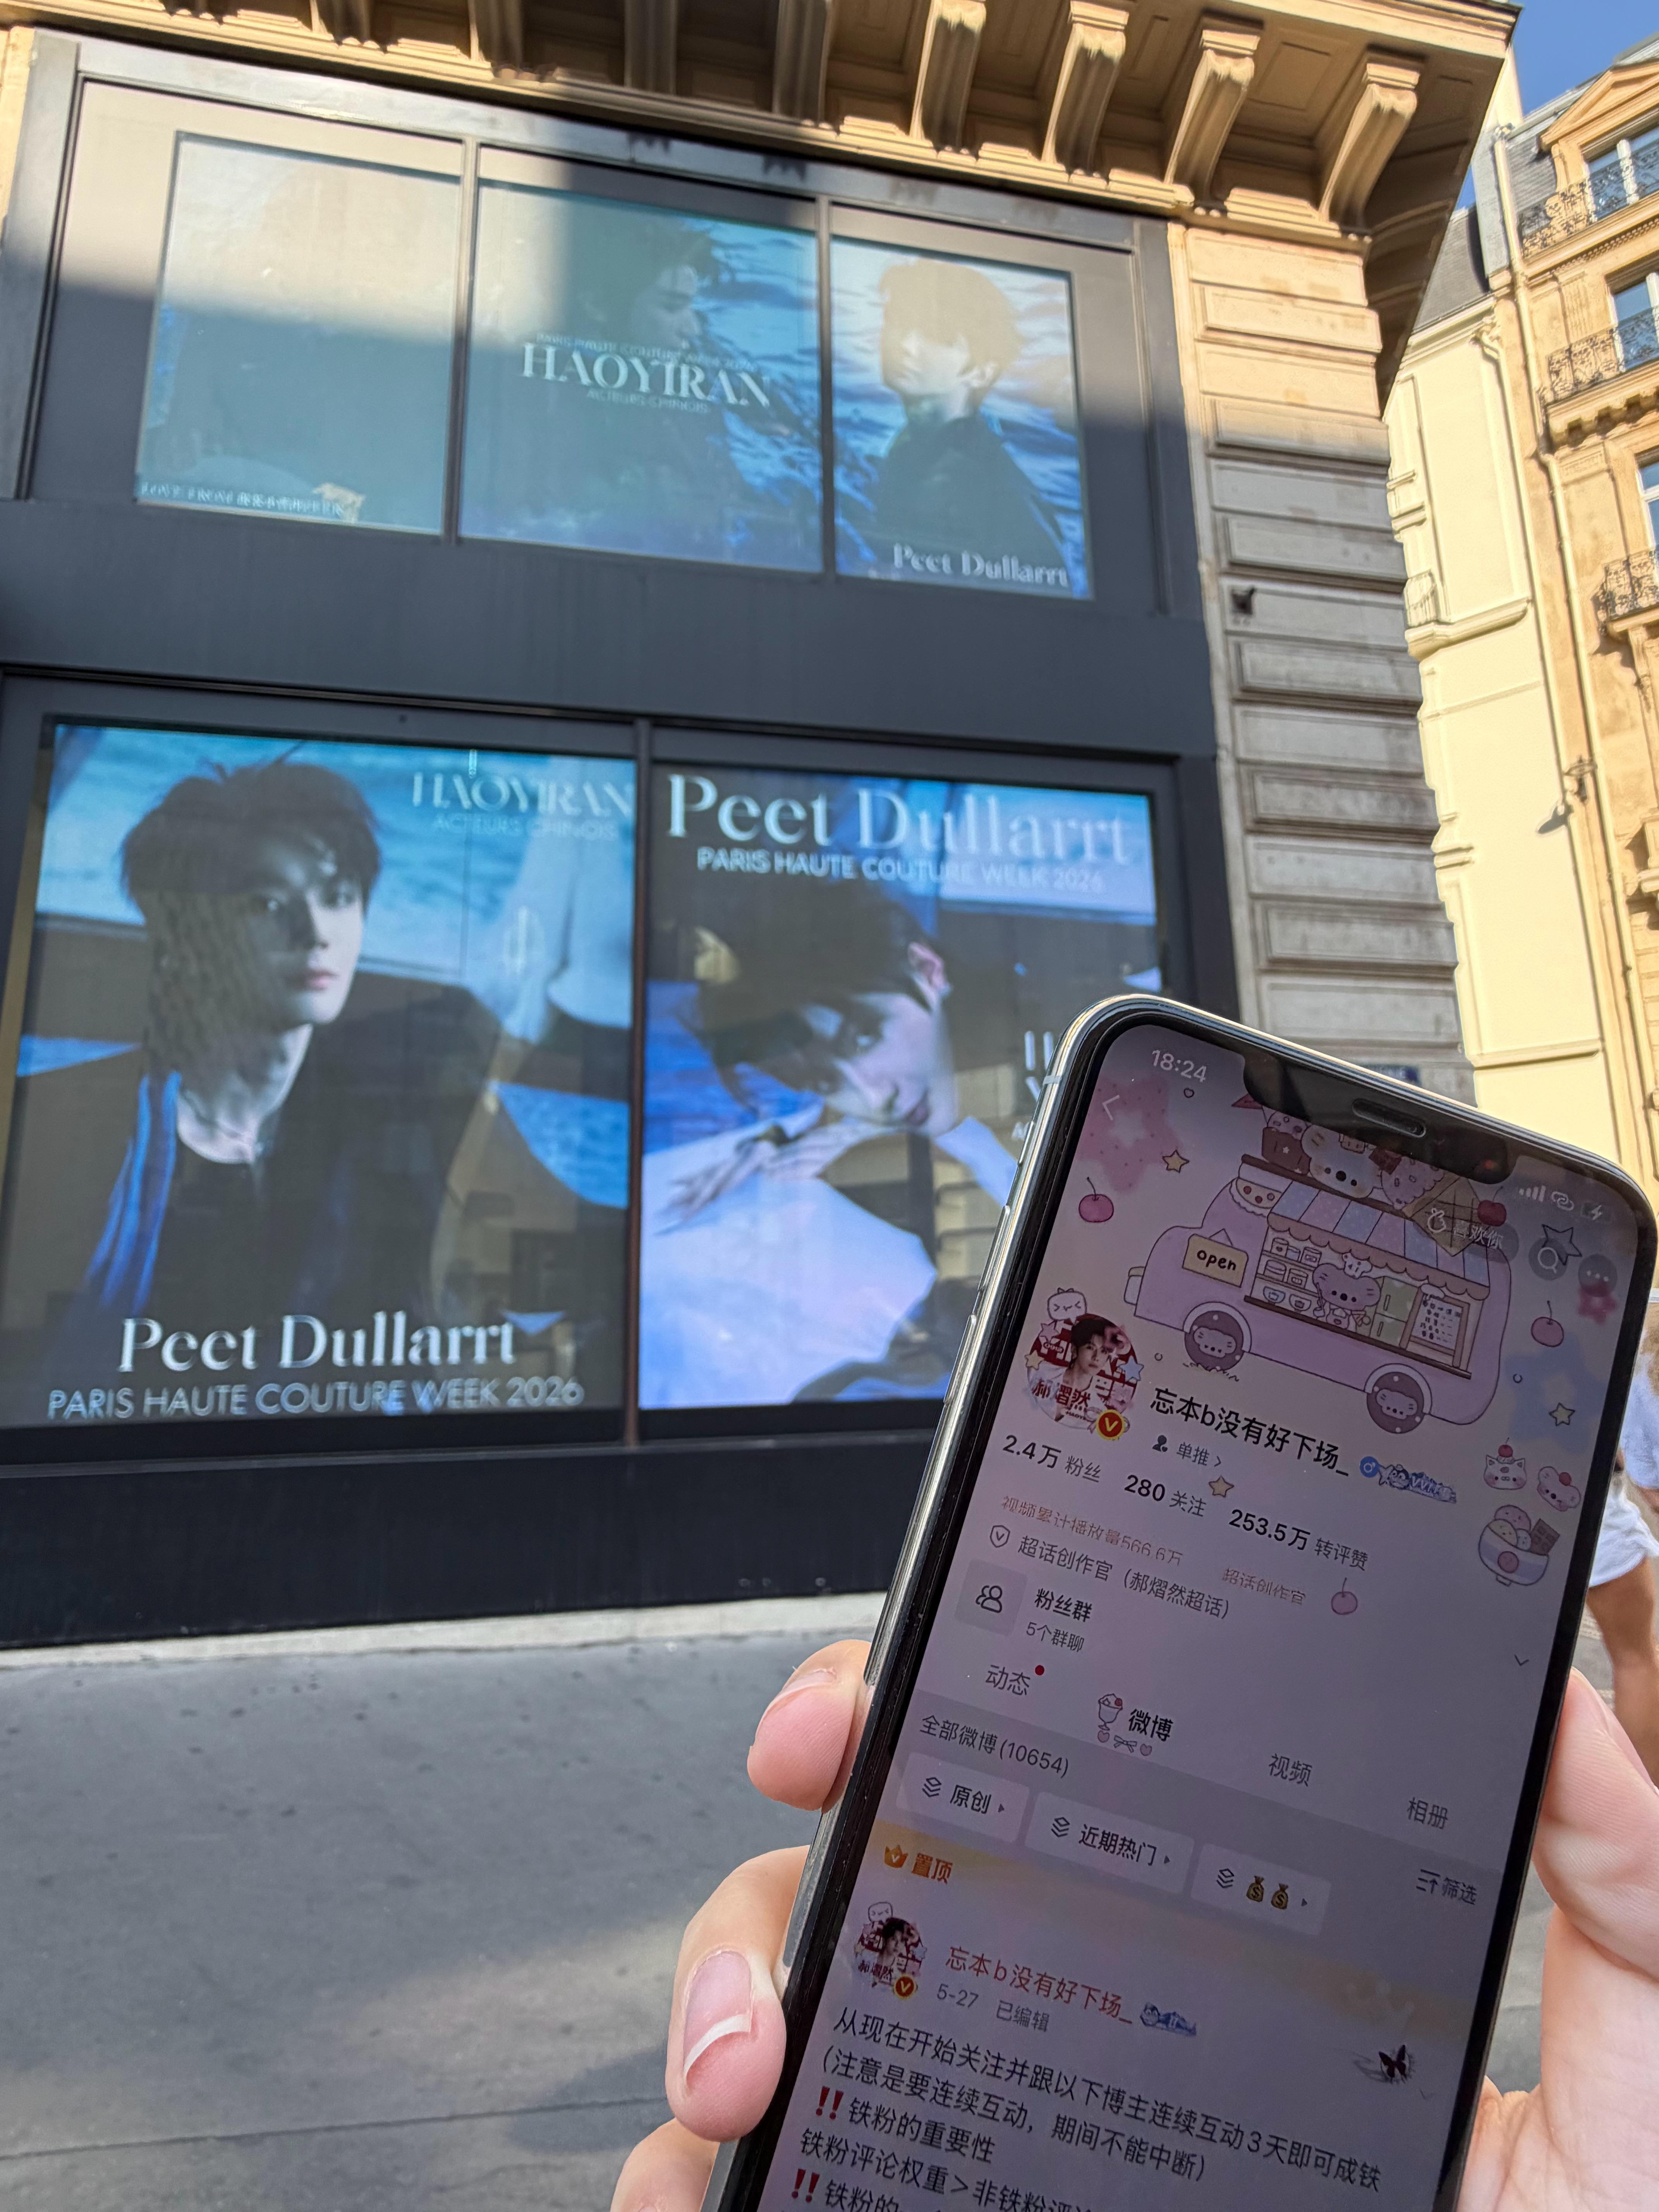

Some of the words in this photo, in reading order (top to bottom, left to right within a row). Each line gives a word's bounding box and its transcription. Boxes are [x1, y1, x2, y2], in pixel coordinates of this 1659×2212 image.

[893, 542, 953, 575] Peet
[961, 550, 1068, 587] Dullarrt
[667, 774, 832, 846] Peet
[856, 788, 1128, 866] Dullarrt
[697, 846, 771, 874] PARIS
[775, 851, 858, 880] HAUTE
[861, 856, 970, 884] COUTURE
[1151, 1049, 1208, 1083] 18:24
[1196, 1249, 1238, 1272] open
[117, 1317, 259, 1372] Peet
[278, 1310, 517, 1368] Dullarrt
[47, 1387, 134, 1420] PARIS
[143, 1382, 248, 1418] HAUTE
[255, 1379, 405, 1414] COUTURE
[411, 1377, 501, 1410] WEEK
[506, 1375, 584, 1407] 2026
[1150, 1387, 1349, 1477] 忘本b没有好下场_
[1176, 1442, 1210, 1467] 单推
[1002, 1434, 1062, 1469] 2.4万
[1065, 1455, 1102, 1483] 粉丝
[1124, 1475, 1165, 1502] 280
[1169, 1490, 1208, 1518] 关注
[1229, 1509, 1310, 1550] 253.5万
[1314, 1537, 1369, 1571] 转评赞
[1034, 1588, 1093, 1623] 粉丝群
[1026, 1621, 1084, 1653] 5个群聊
[985, 1664, 1030, 1696] 动态
[1128, 1709, 1174, 1742] 微博
[1268, 1753, 1313, 1787] 视频
[1407, 1797, 1449, 1829] 相册
[950, 1784, 992, 1815] 原创
[1079, 1824, 1157, 1867] 近期热门
[911, 1852, 953, 1884] 置顶
[1441, 1877, 1478, 1906] 筛选
[936, 1983, 979, 2009] 5-27
[996, 2000, 1050, 2032] 已编辑
[945, 1946, 1133, 2025] 忘本b没有好下场_
